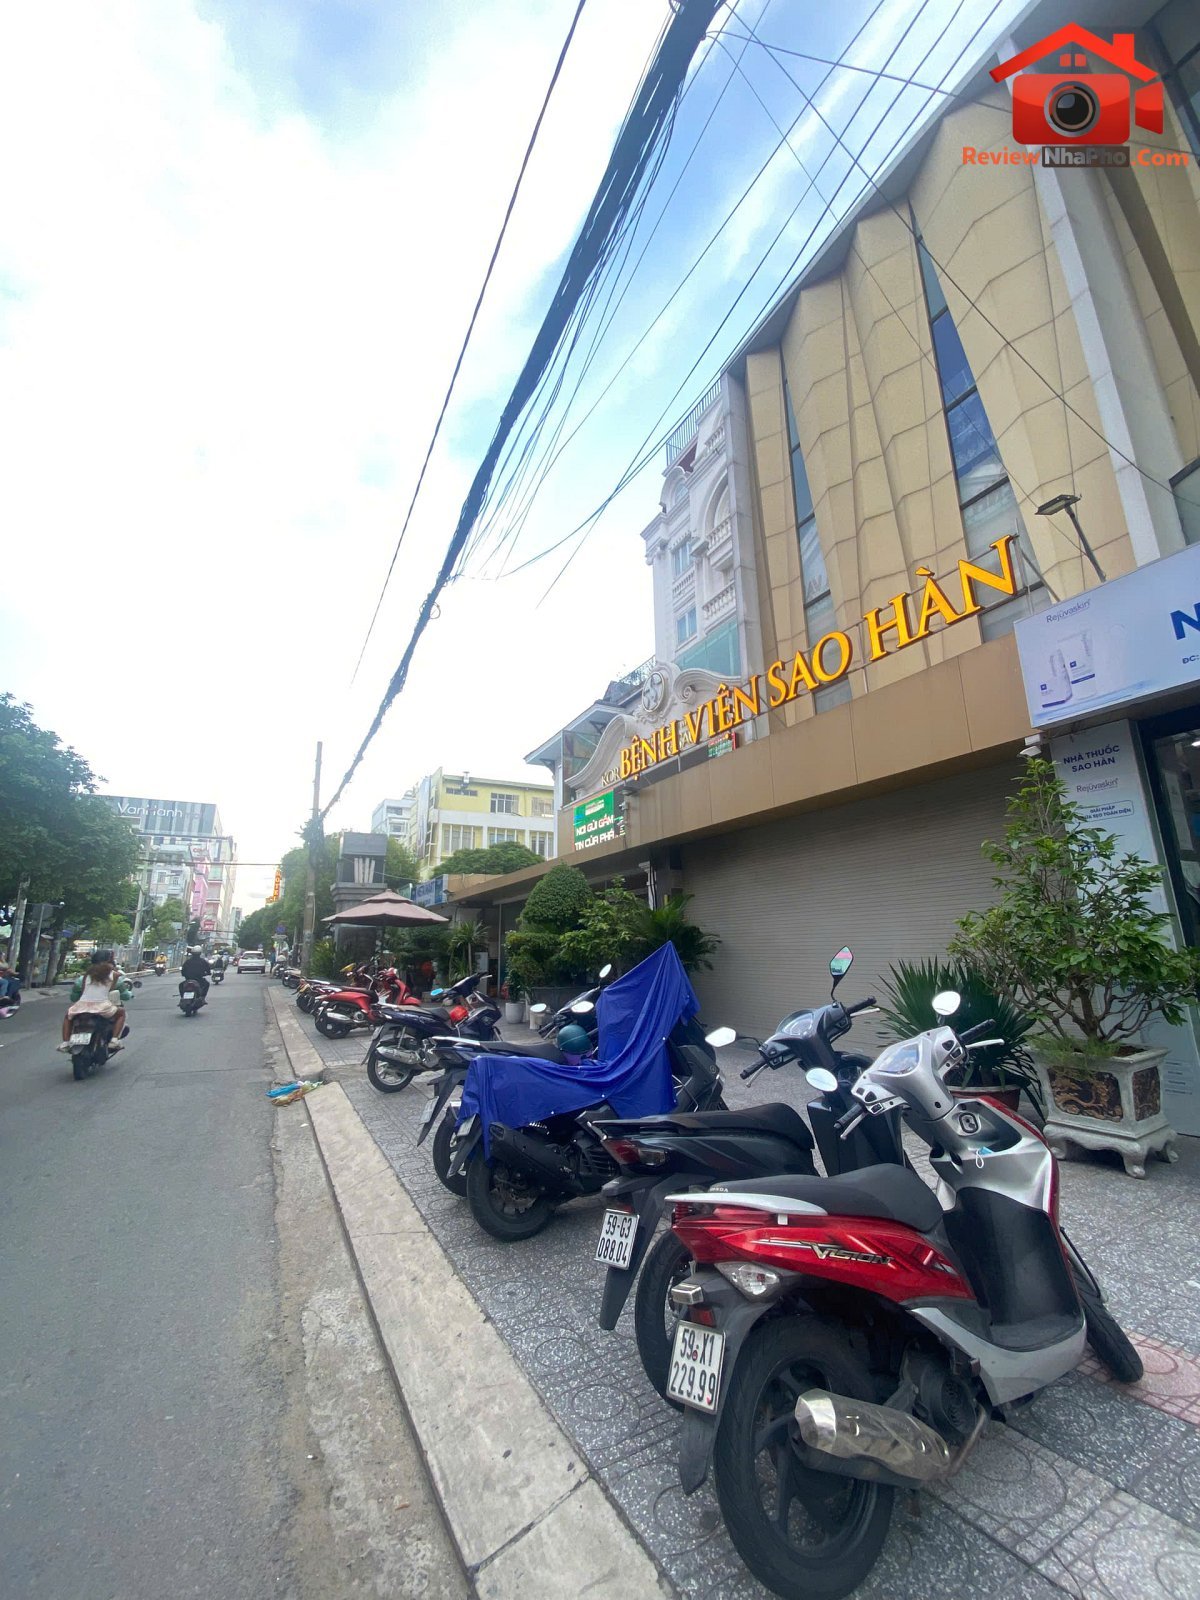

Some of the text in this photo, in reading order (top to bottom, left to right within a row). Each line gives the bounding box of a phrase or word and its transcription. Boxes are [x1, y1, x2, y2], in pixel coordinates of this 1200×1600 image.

[620, 720, 680, 781] BỆNH
[683, 673, 761, 744] VIỆN
[767, 630, 852, 708] SAO
[862, 534, 1019, 663] HÀN
[1063, 744, 1120, 764] NHÀ THUỐC
[1072, 756, 1116, 772] SAO HÀN
[605, 1214, 632, 1239] 59-G3
[597, 1237, 628, 1264] 088.04
[680, 1328, 715, 1367] 59-X1
[670, 1361, 716, 1406] 229.99
